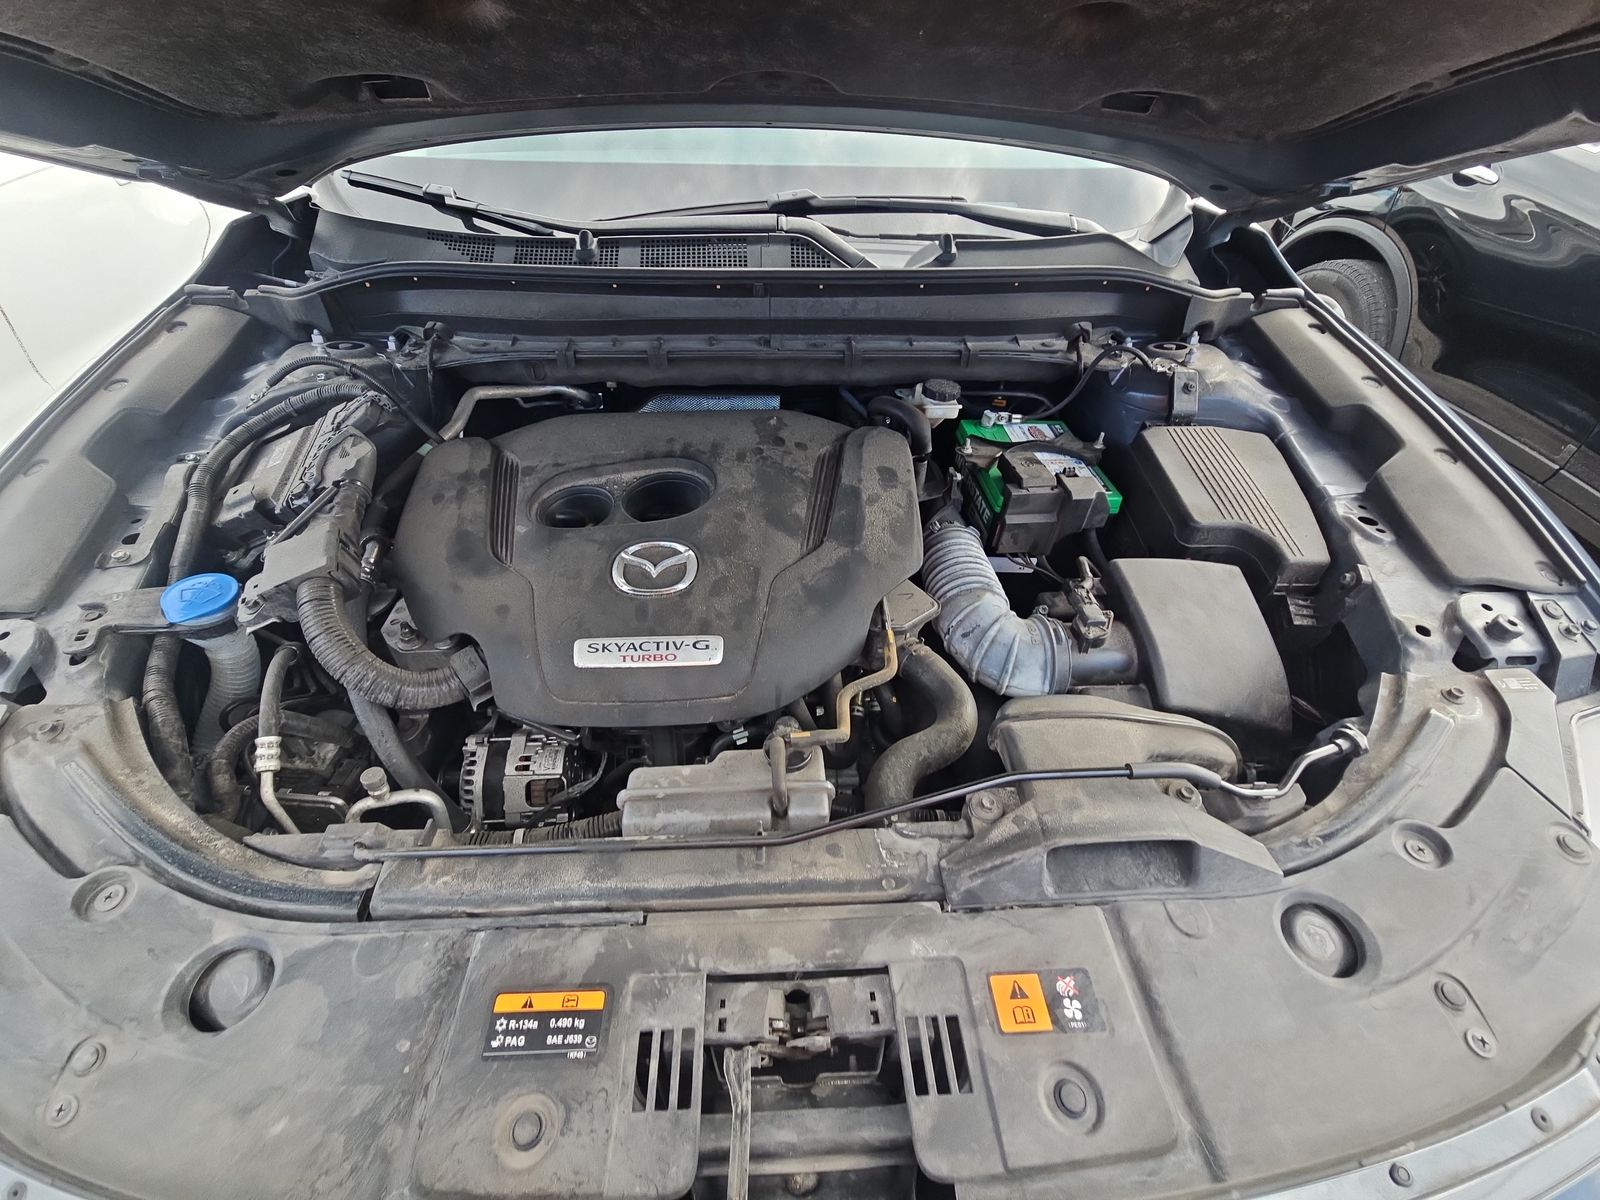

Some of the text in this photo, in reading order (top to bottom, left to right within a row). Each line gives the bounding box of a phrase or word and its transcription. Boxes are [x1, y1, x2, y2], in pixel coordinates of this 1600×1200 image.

[587, 640, 710, 653] SKYACTIV-G
[619, 653, 677, 663] TURBO
[574, 1017, 585, 1030] kg
[504, 1035, 525, 1047] PAG
[546, 1034, 563, 1045] SAE
